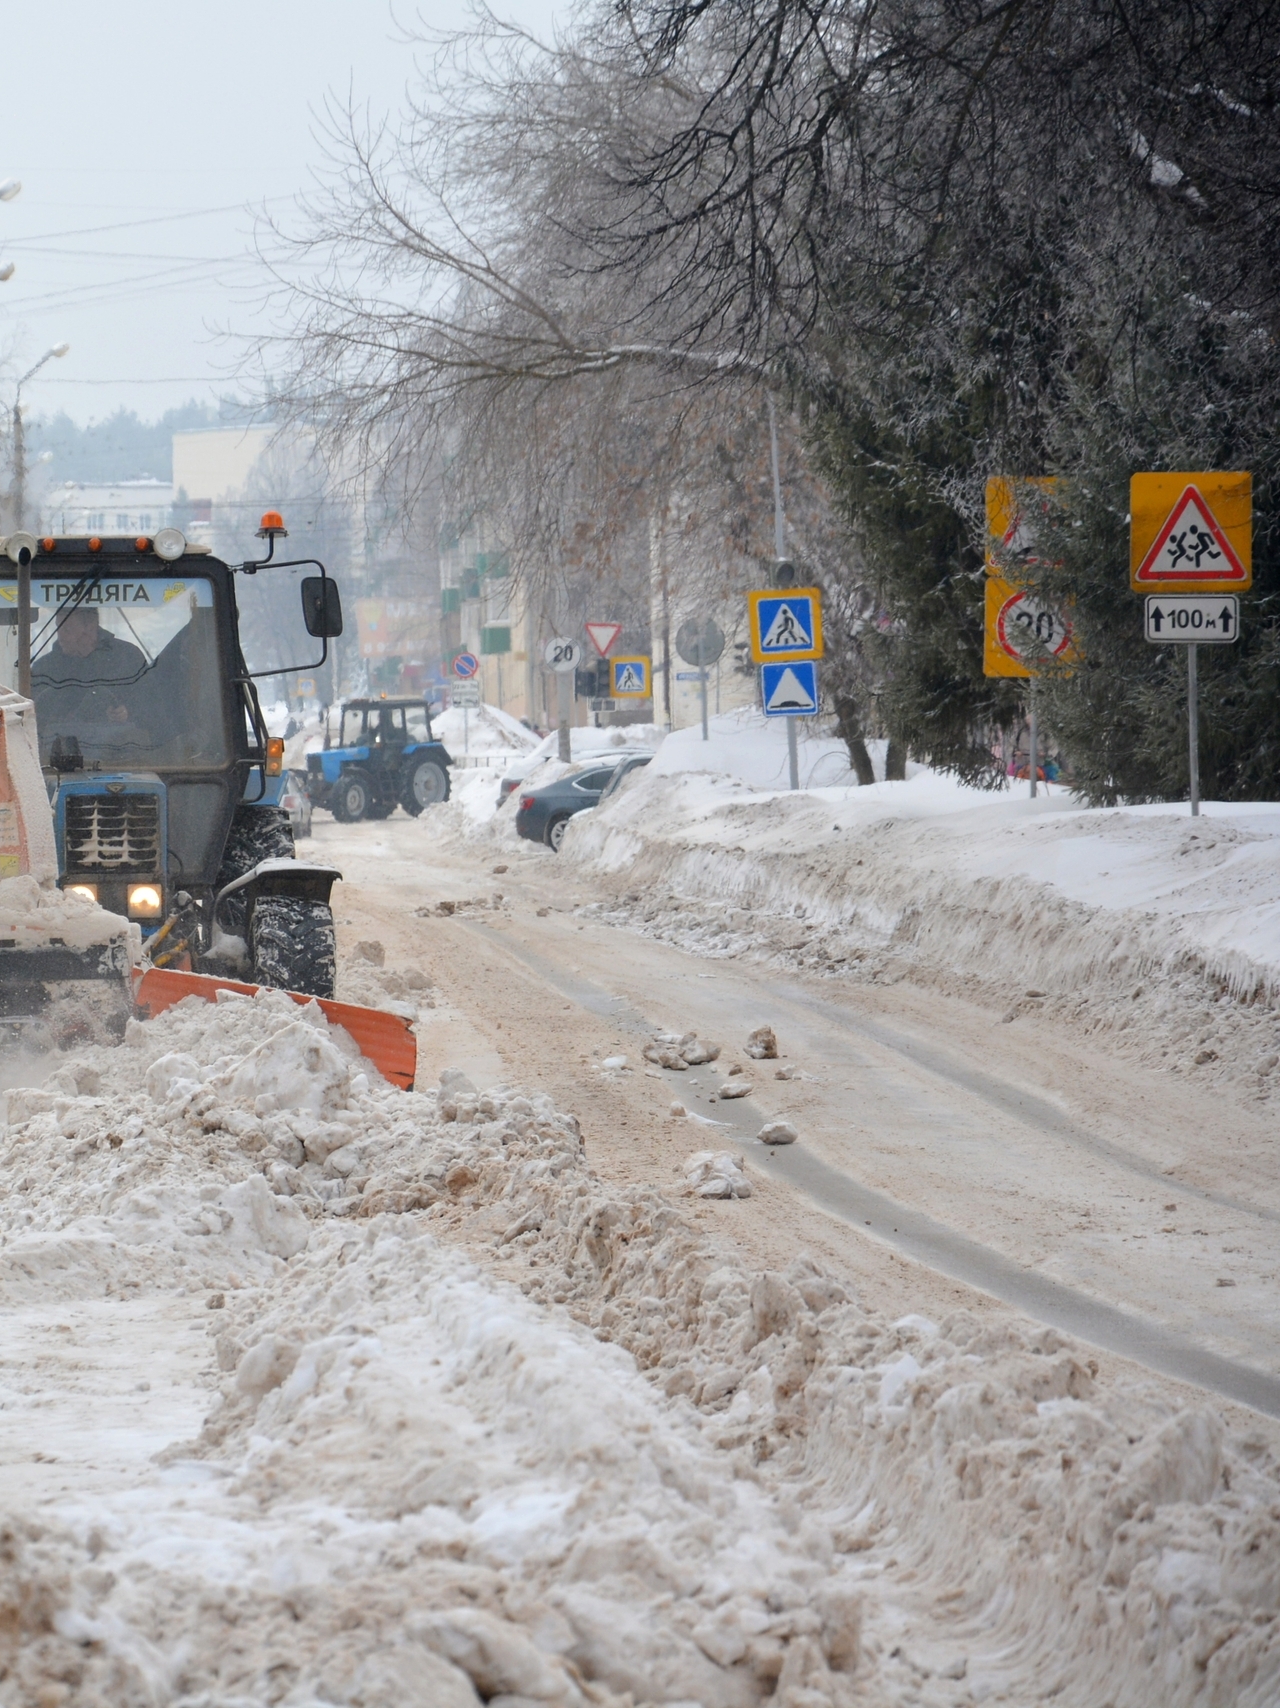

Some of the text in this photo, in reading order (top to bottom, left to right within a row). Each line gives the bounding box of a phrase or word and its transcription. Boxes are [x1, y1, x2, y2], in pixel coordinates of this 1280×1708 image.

[40, 583, 150, 604] ТРУДЯГА
[1167, 609, 1203, 629] 100
[553, 645, 573, 662] 20
